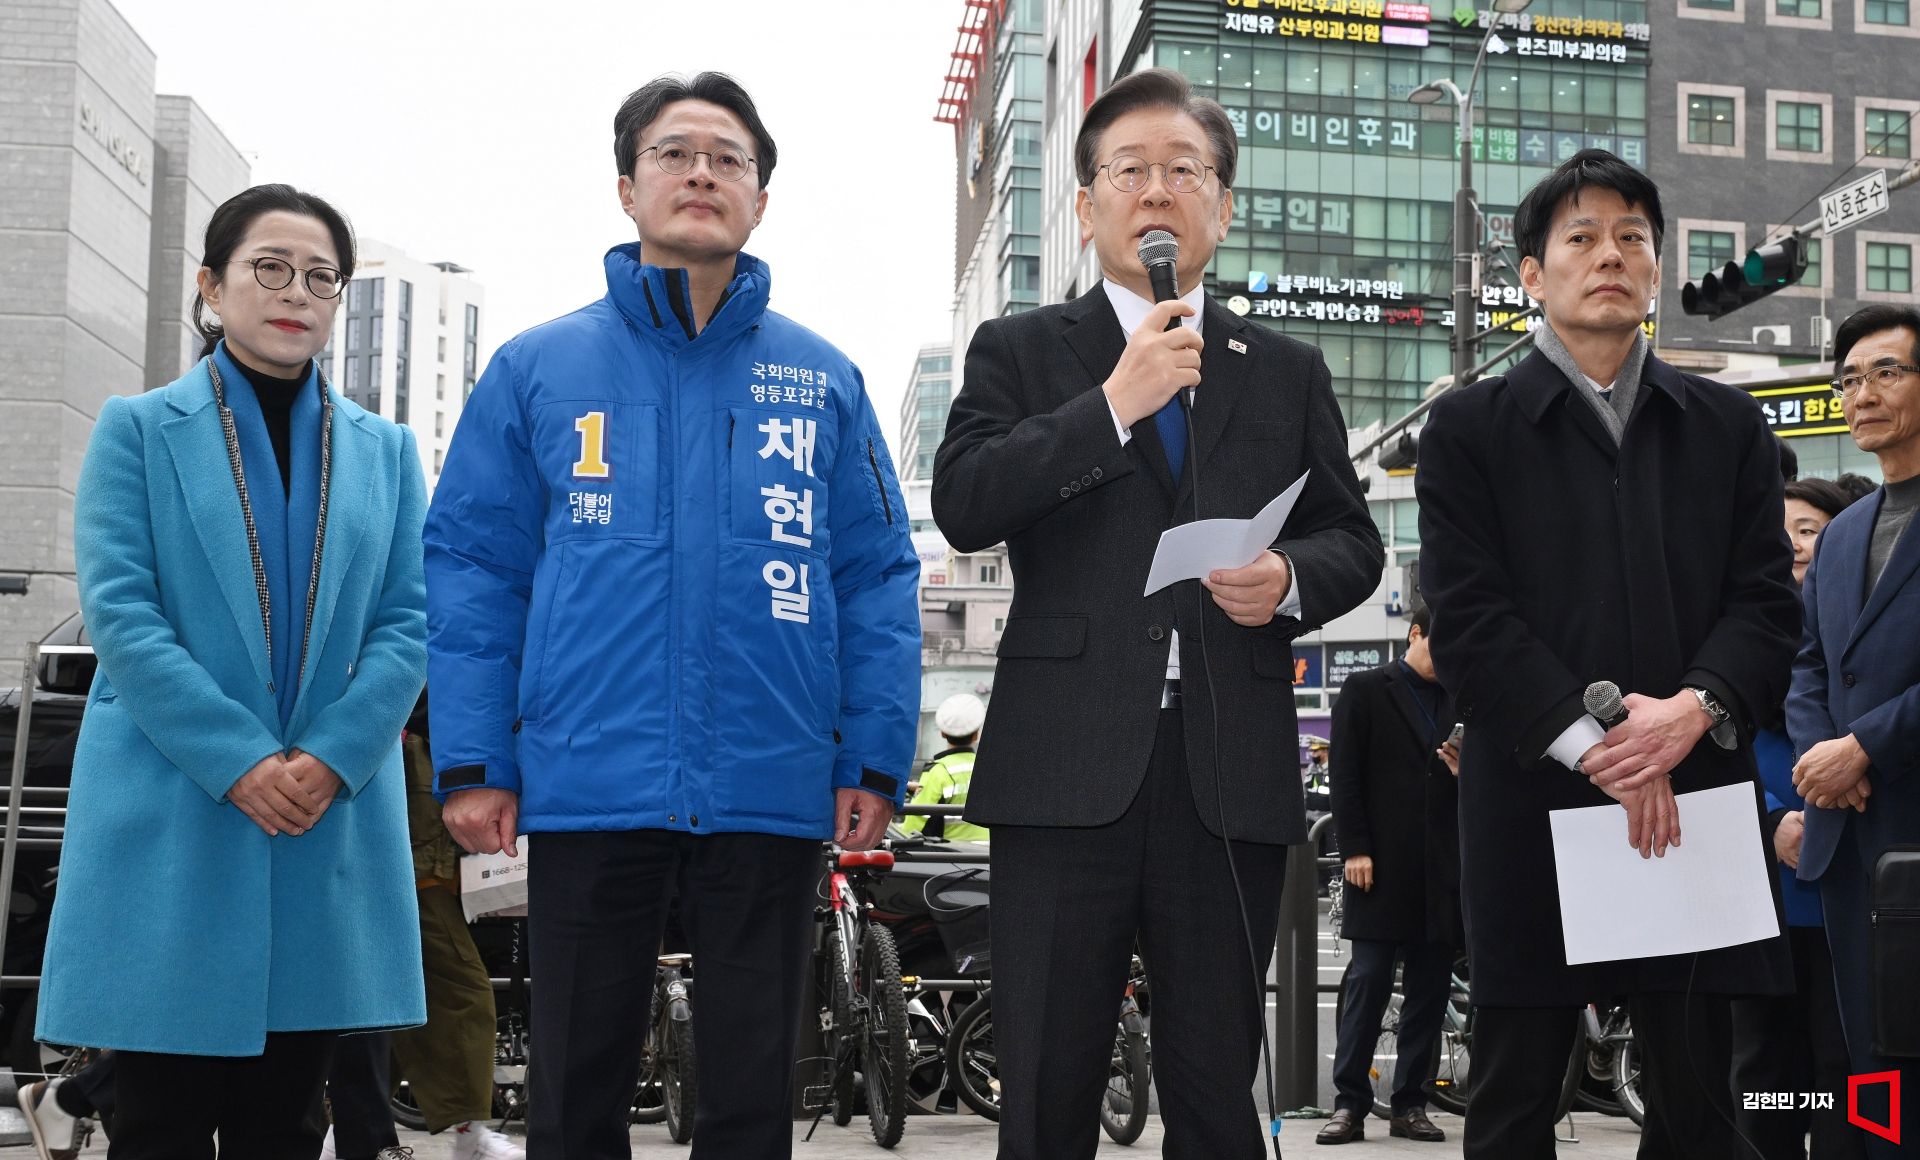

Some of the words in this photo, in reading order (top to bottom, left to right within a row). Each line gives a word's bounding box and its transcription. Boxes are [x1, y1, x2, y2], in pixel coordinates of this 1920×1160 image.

[1225, 12, 1275, 34] 지앤유
[1516, 37, 1627, 63] 퀸즈피부과의원
[1825, 180, 1883, 227] 신호준수
[751, 361, 814, 385] 국회의원
[750, 384, 816, 406] 영등포갑
[572, 411, 610, 478] 1
[569, 491, 612, 508] 더불어
[572, 506, 612, 524] 민주당
[757, 418, 817, 625] 채현일
[491, 862, 528, 877] 1668-125
